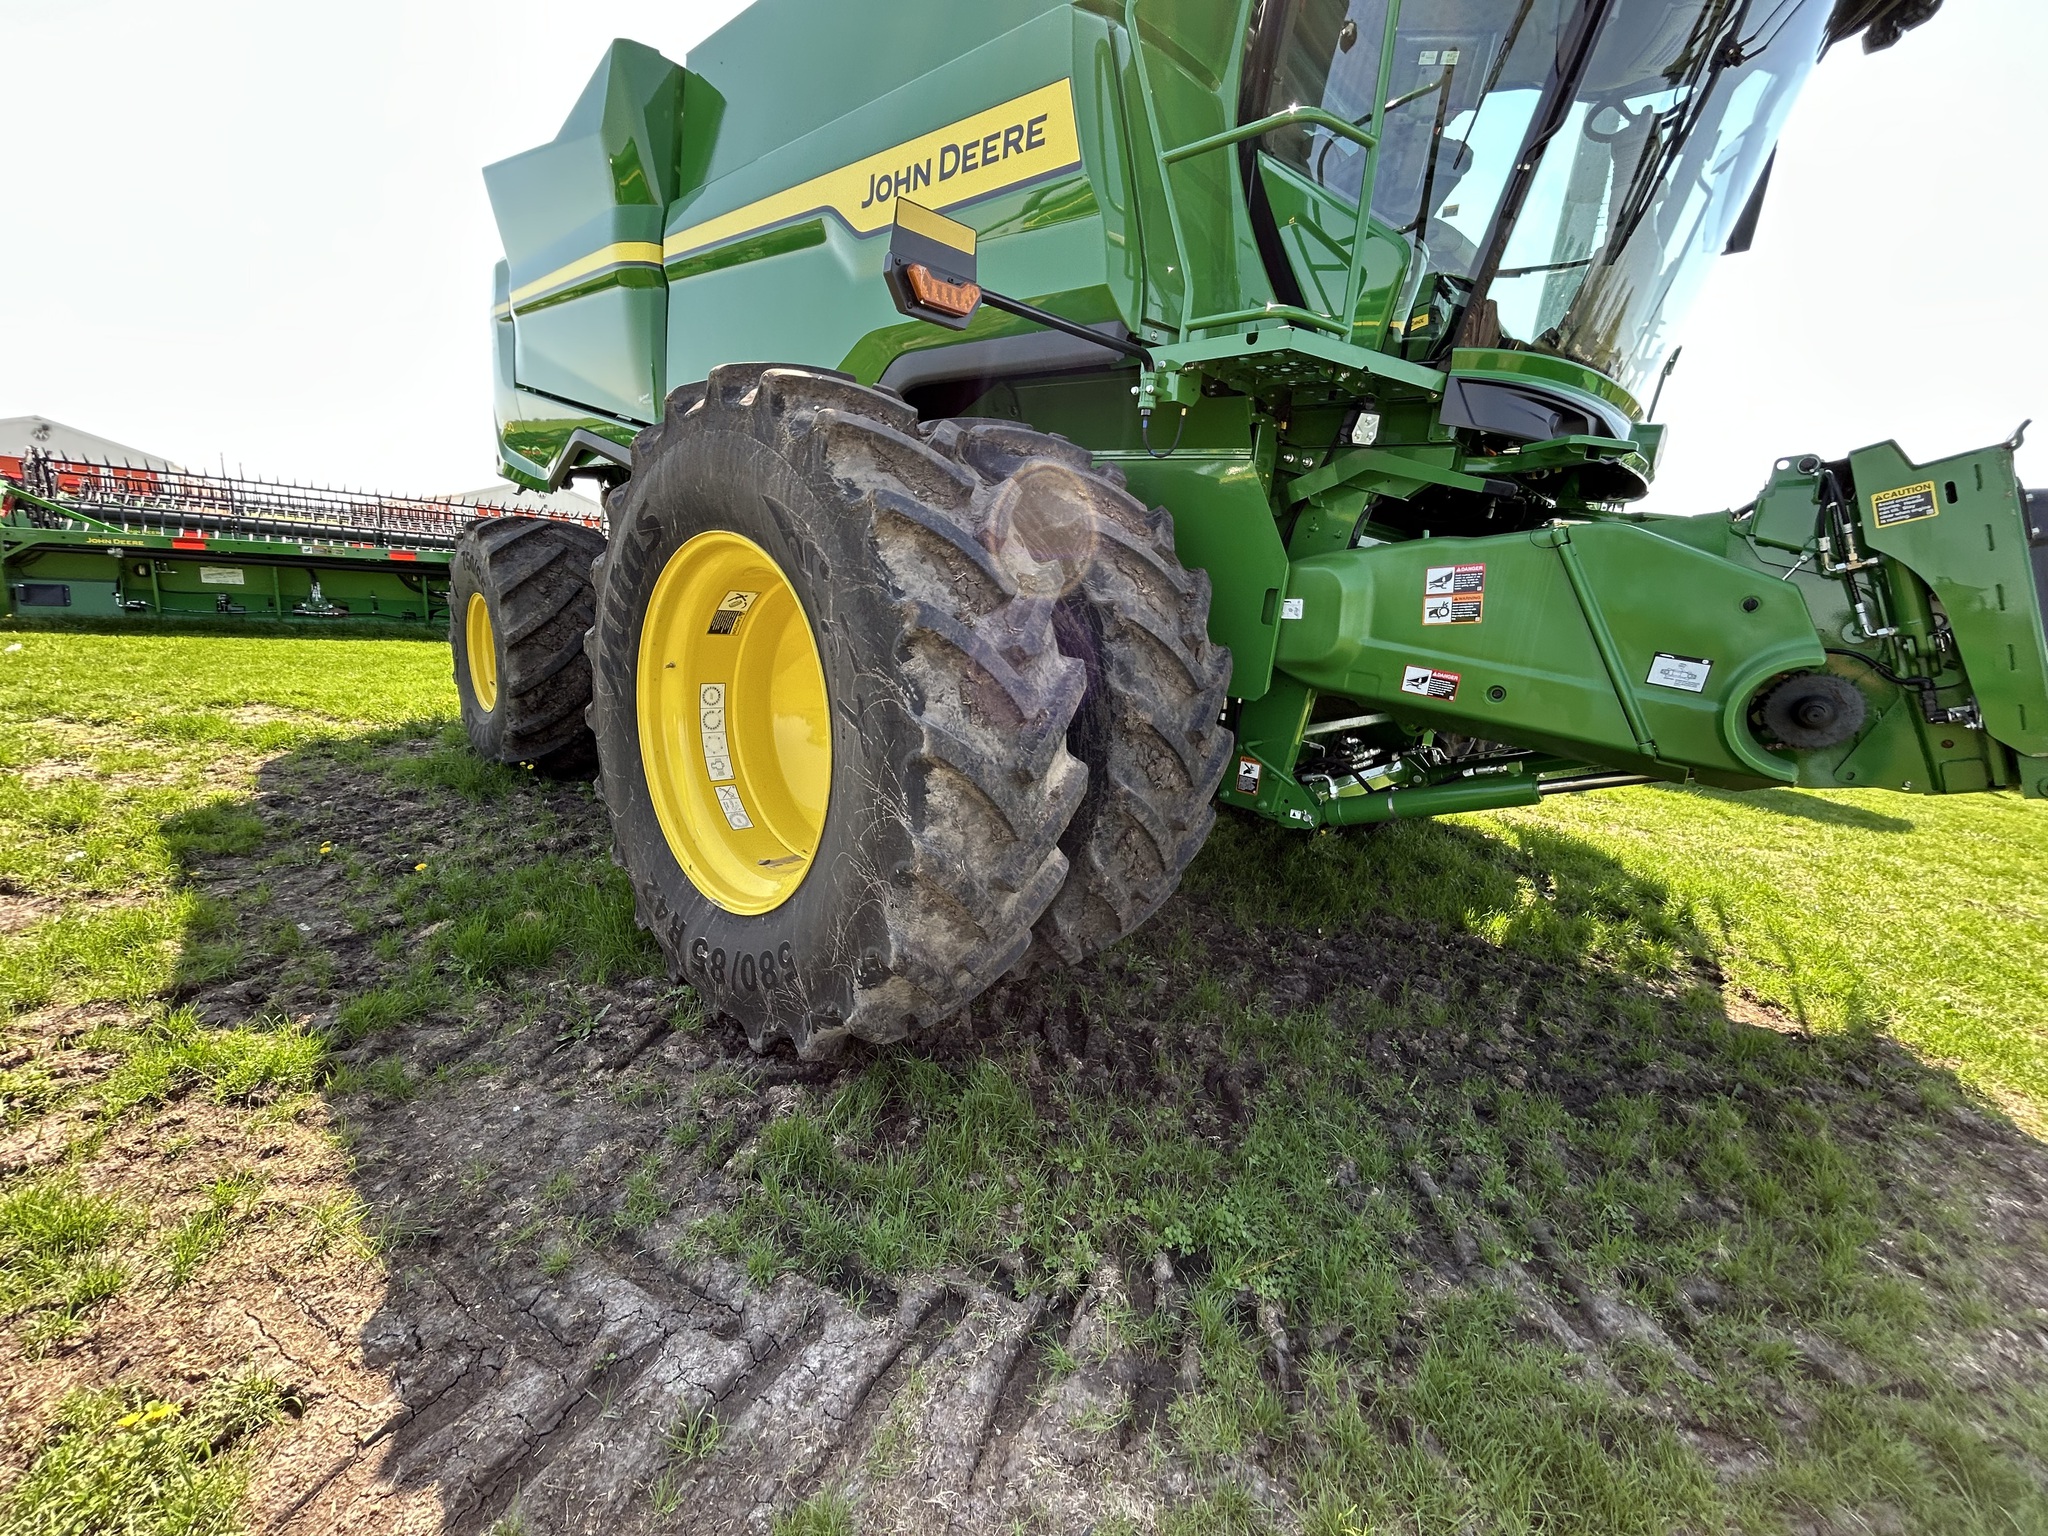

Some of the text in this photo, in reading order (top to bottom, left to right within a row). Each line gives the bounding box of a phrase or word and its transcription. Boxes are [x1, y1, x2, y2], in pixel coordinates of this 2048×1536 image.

[861, 113, 1048, 209] JOHN DEERE
[1882, 483, 1932, 500] CAUTION
[1436, 672, 1459, 681] DANGER
[690, 936, 799, 992] 580/85
